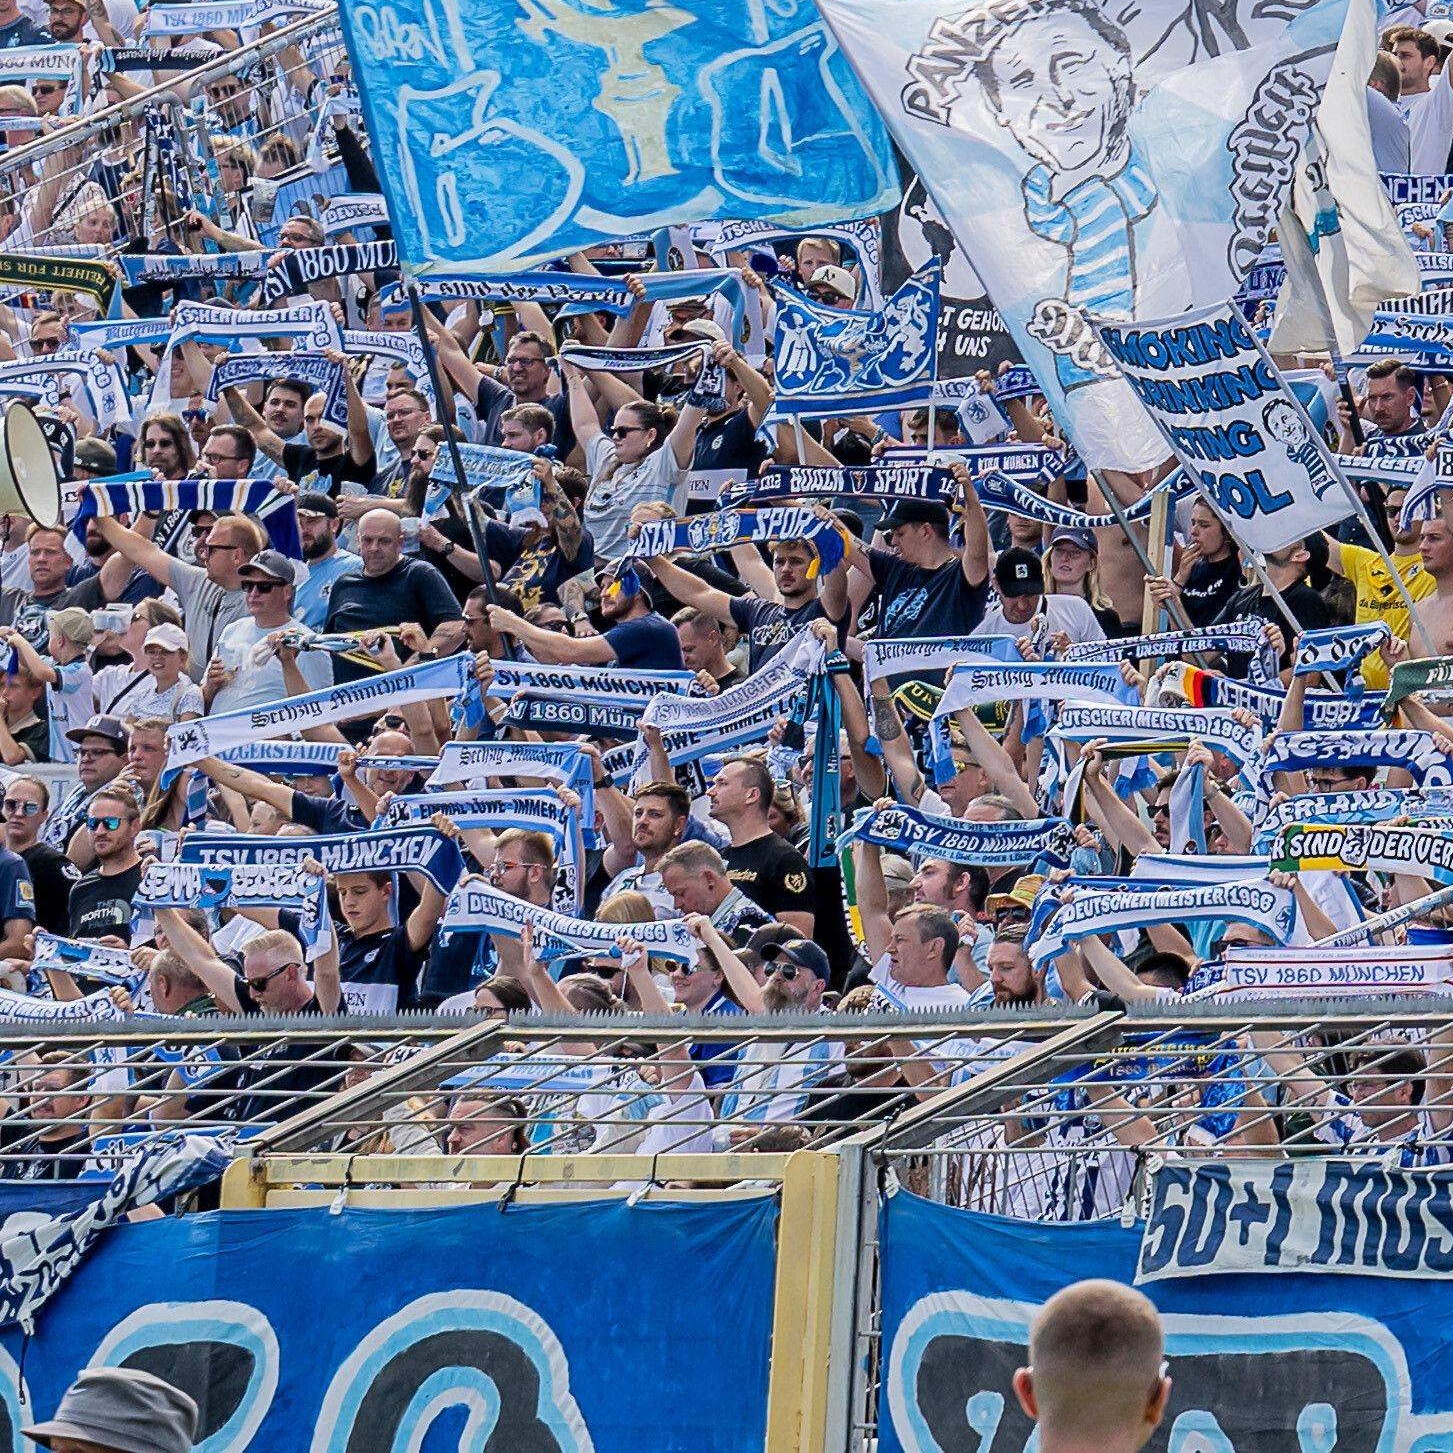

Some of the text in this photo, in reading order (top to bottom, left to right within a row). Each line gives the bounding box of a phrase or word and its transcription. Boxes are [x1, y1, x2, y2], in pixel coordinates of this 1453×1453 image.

[299, 251, 351, 281] 1860
[235, 303, 310, 326] MEISTER
[958, 308, 1008, 332] GEHÖ
[954, 333, 990, 357] UNS
[873, 467, 924, 496] SPORT
[752, 507, 832, 541] SPORT
[524, 671, 570, 690] 1860
[712, 661, 792, 703] MÜNCHEN
[1038, 667, 1117, 693] München
[250, 673, 418, 731] Sechzig München
[529, 702, 576, 723] 1860
[1142, 708, 1209, 732] MEISTER
[905, 819, 1054, 852] TSV 1860 MÜNCHEN
[1286, 829, 1410, 859] SIND DER
[322, 837, 442, 873] MÜNCHEN
[1153, 885, 1226, 909] MEISTER
[1228, 883, 1276, 912] 1966
[1232, 962, 1426, 986] TSV 1860 MÜNCHEN
[1142, 1163, 1288, 1277] 50+1
